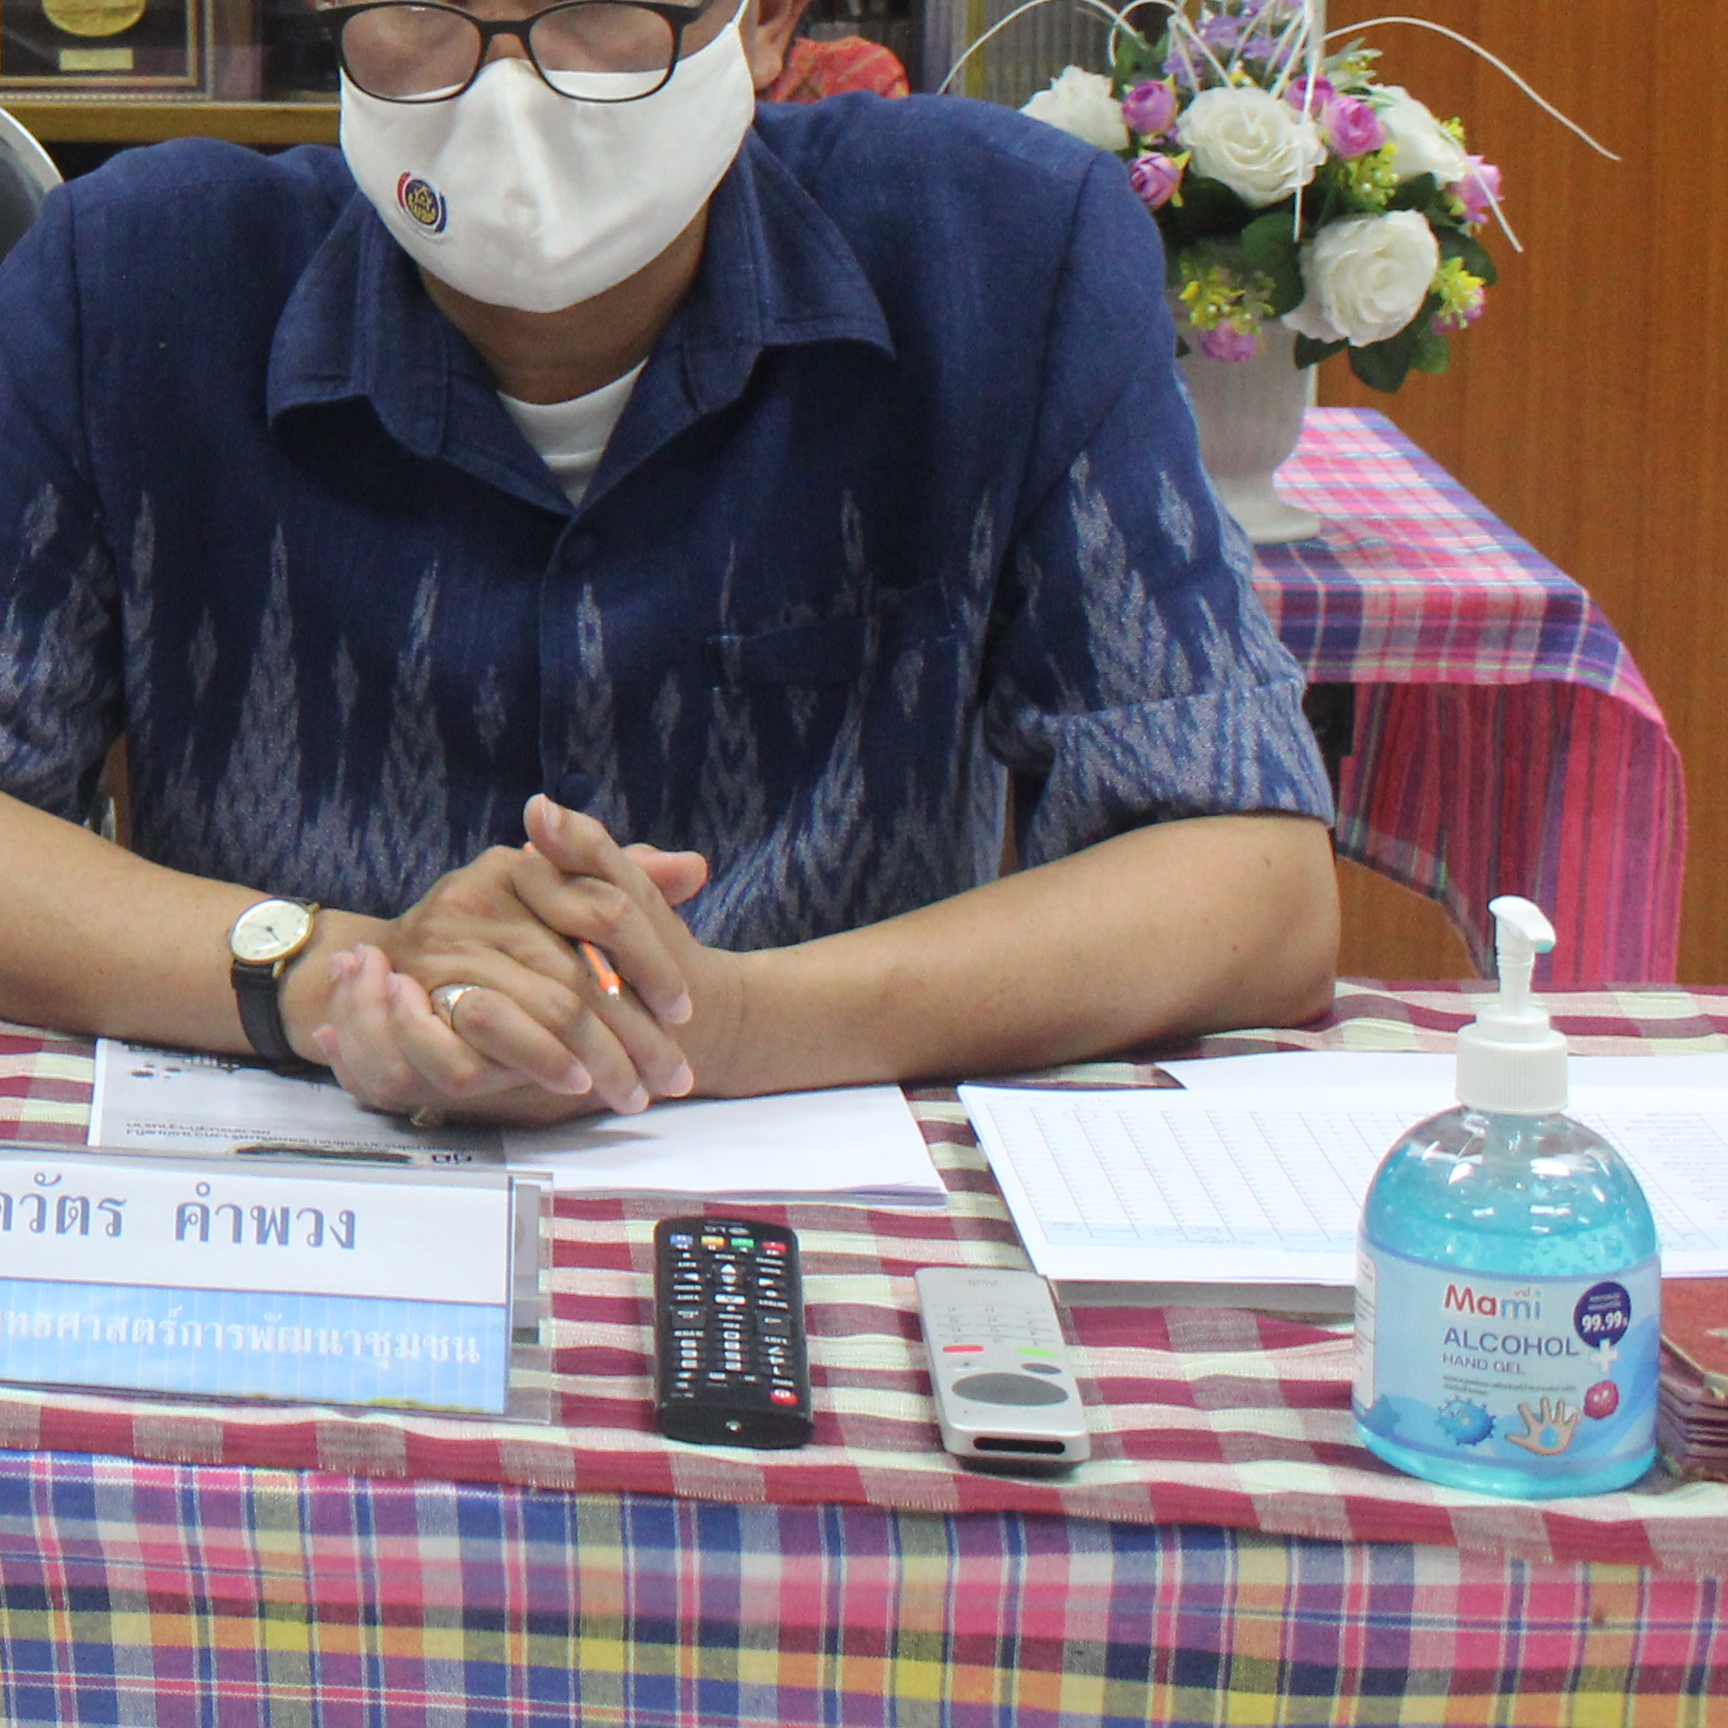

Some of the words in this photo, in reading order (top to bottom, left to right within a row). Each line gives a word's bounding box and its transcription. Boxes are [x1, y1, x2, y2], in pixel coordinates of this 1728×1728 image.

[174, 1184, 359, 1251] คำพวง
[1444, 1283, 1541, 1320] Mami
[1443, 1327, 1580, 1356] ALCOHOL
[1442, 1352, 1488, 1373] HAND
[1493, 1361, 1526, 1375] GEL
